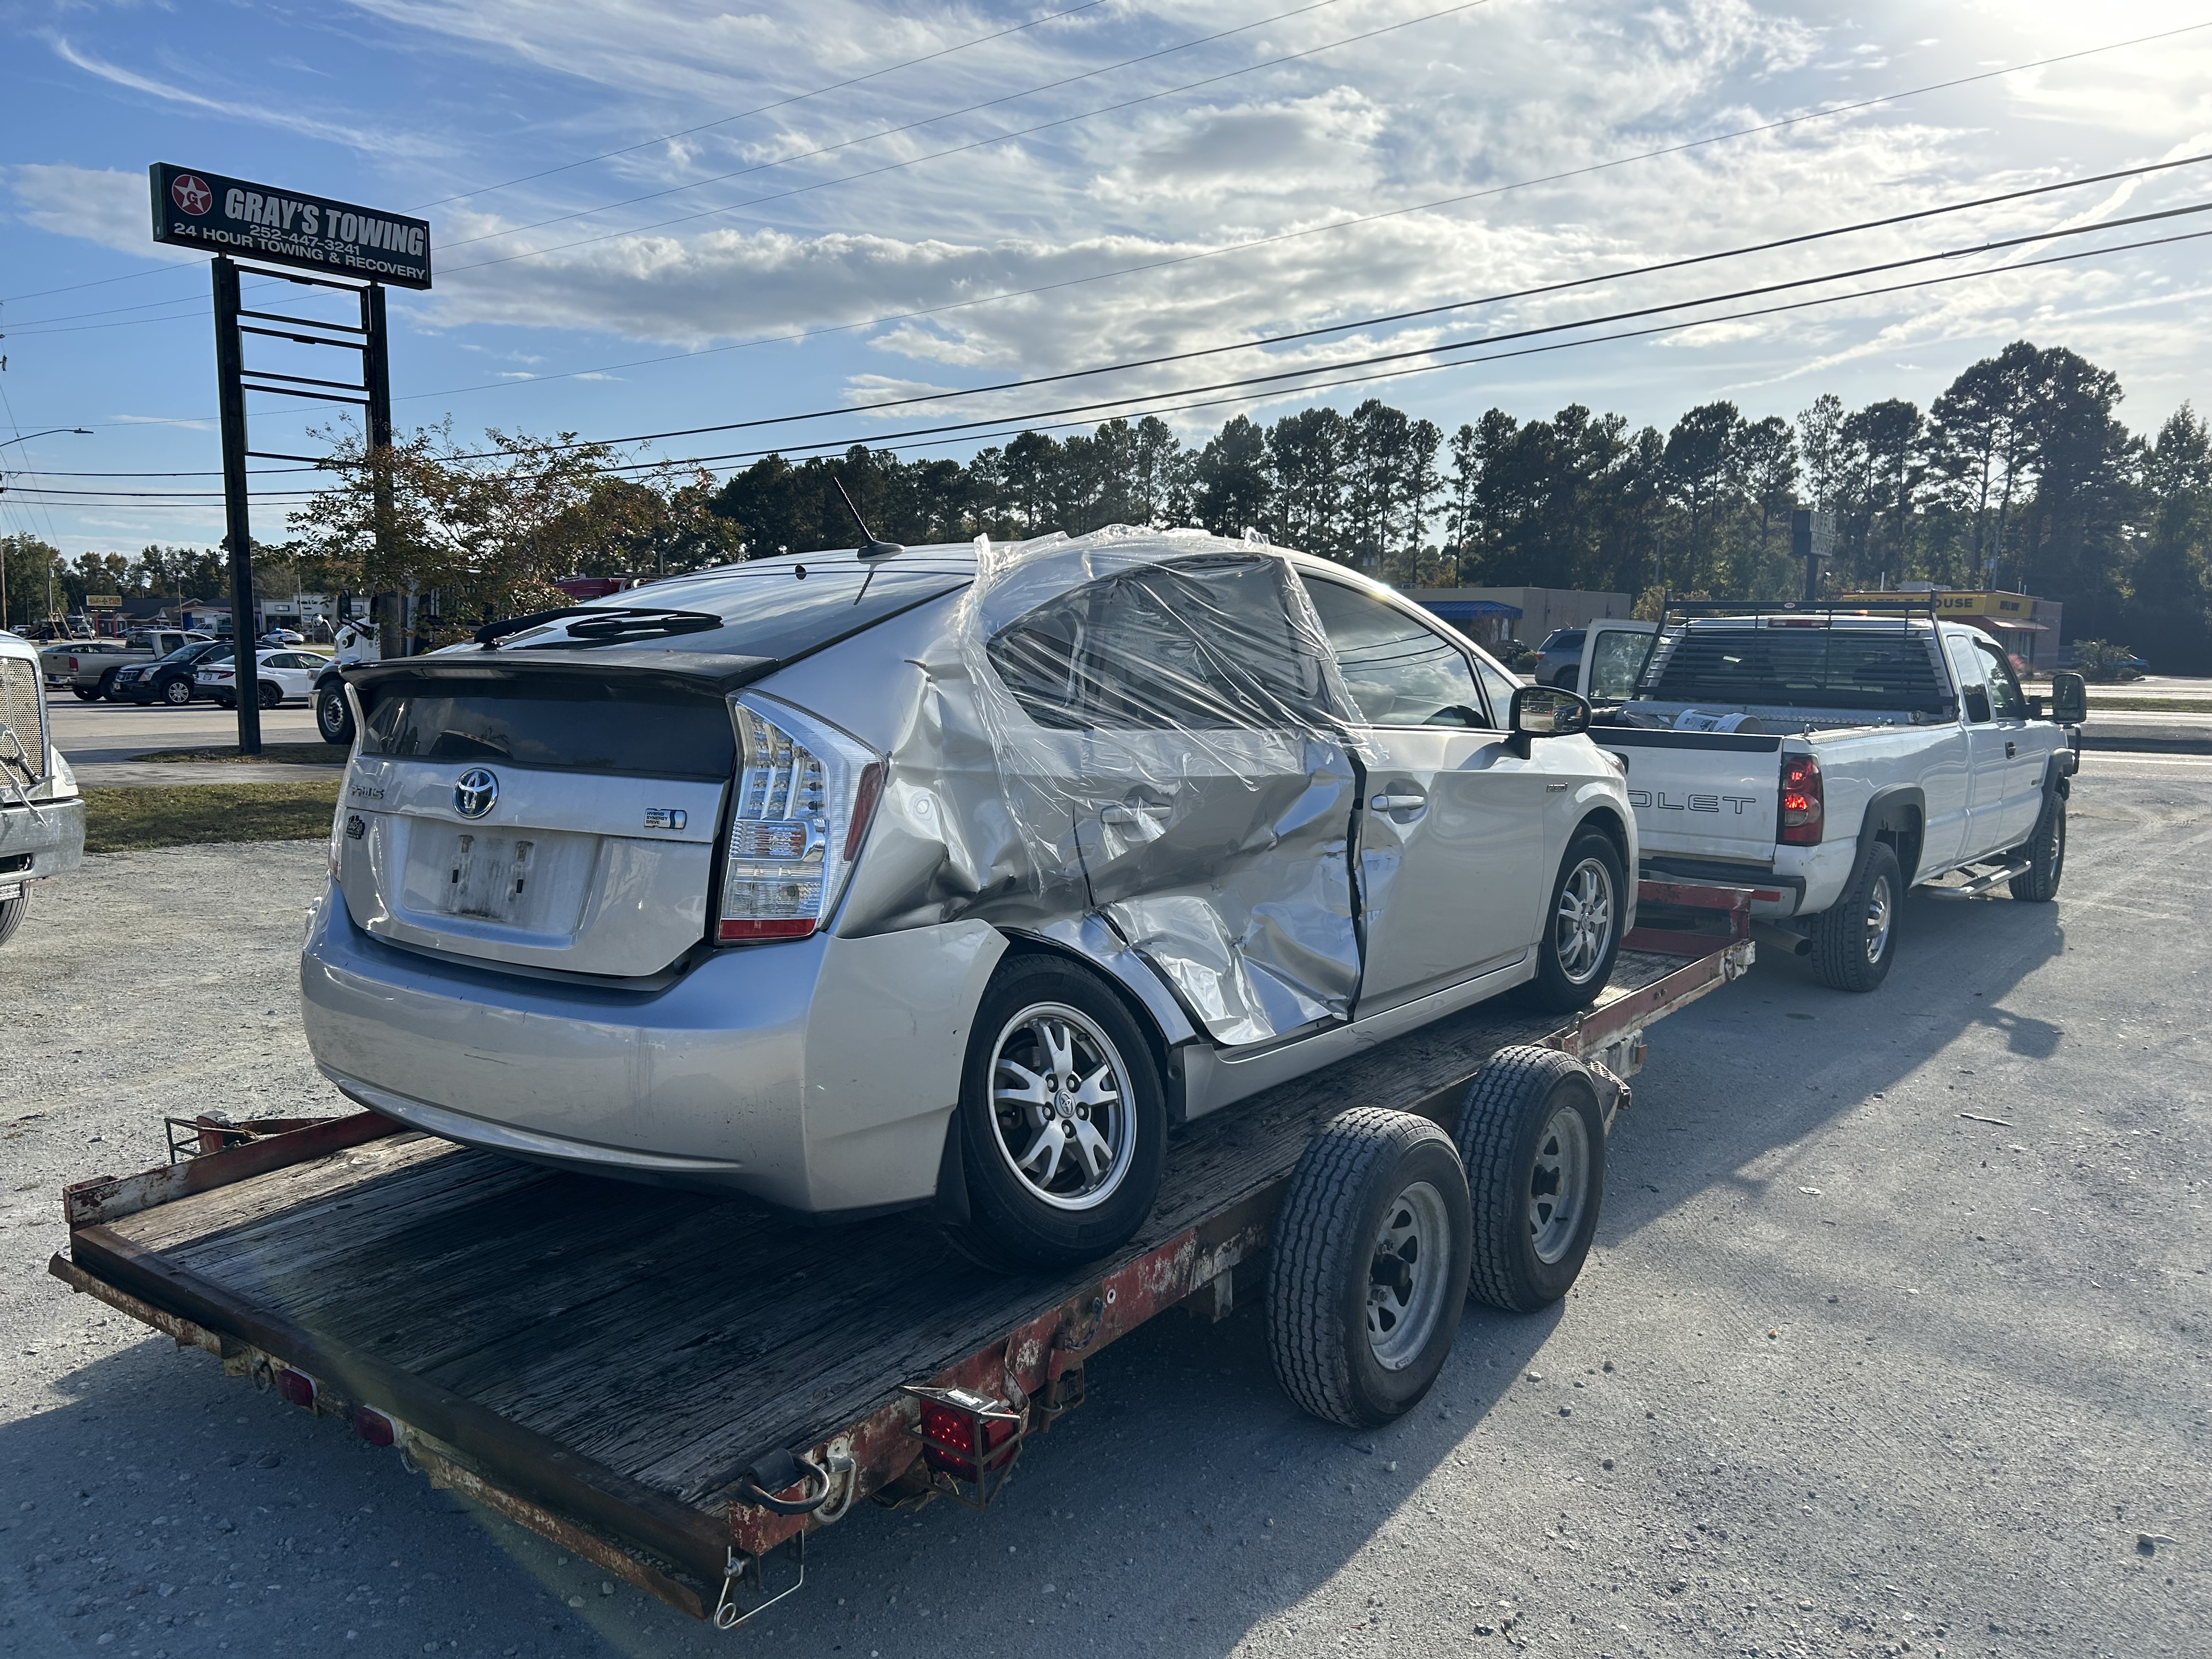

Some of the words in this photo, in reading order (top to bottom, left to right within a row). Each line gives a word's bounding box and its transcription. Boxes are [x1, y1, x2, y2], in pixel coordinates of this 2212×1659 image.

[187, 191, 199, 205] G
[224, 188, 319, 235] GRAY'S
[325, 208, 424, 257] TOWING
[250, 224, 360, 256] 252-447-3241
[174, 222, 198, 237] 24
[202, 227, 253, 247] HOUR
[257, 237, 324, 261] TOWING
[329, 252, 341, 264] &
[345, 254, 426, 280] RECOVERY
